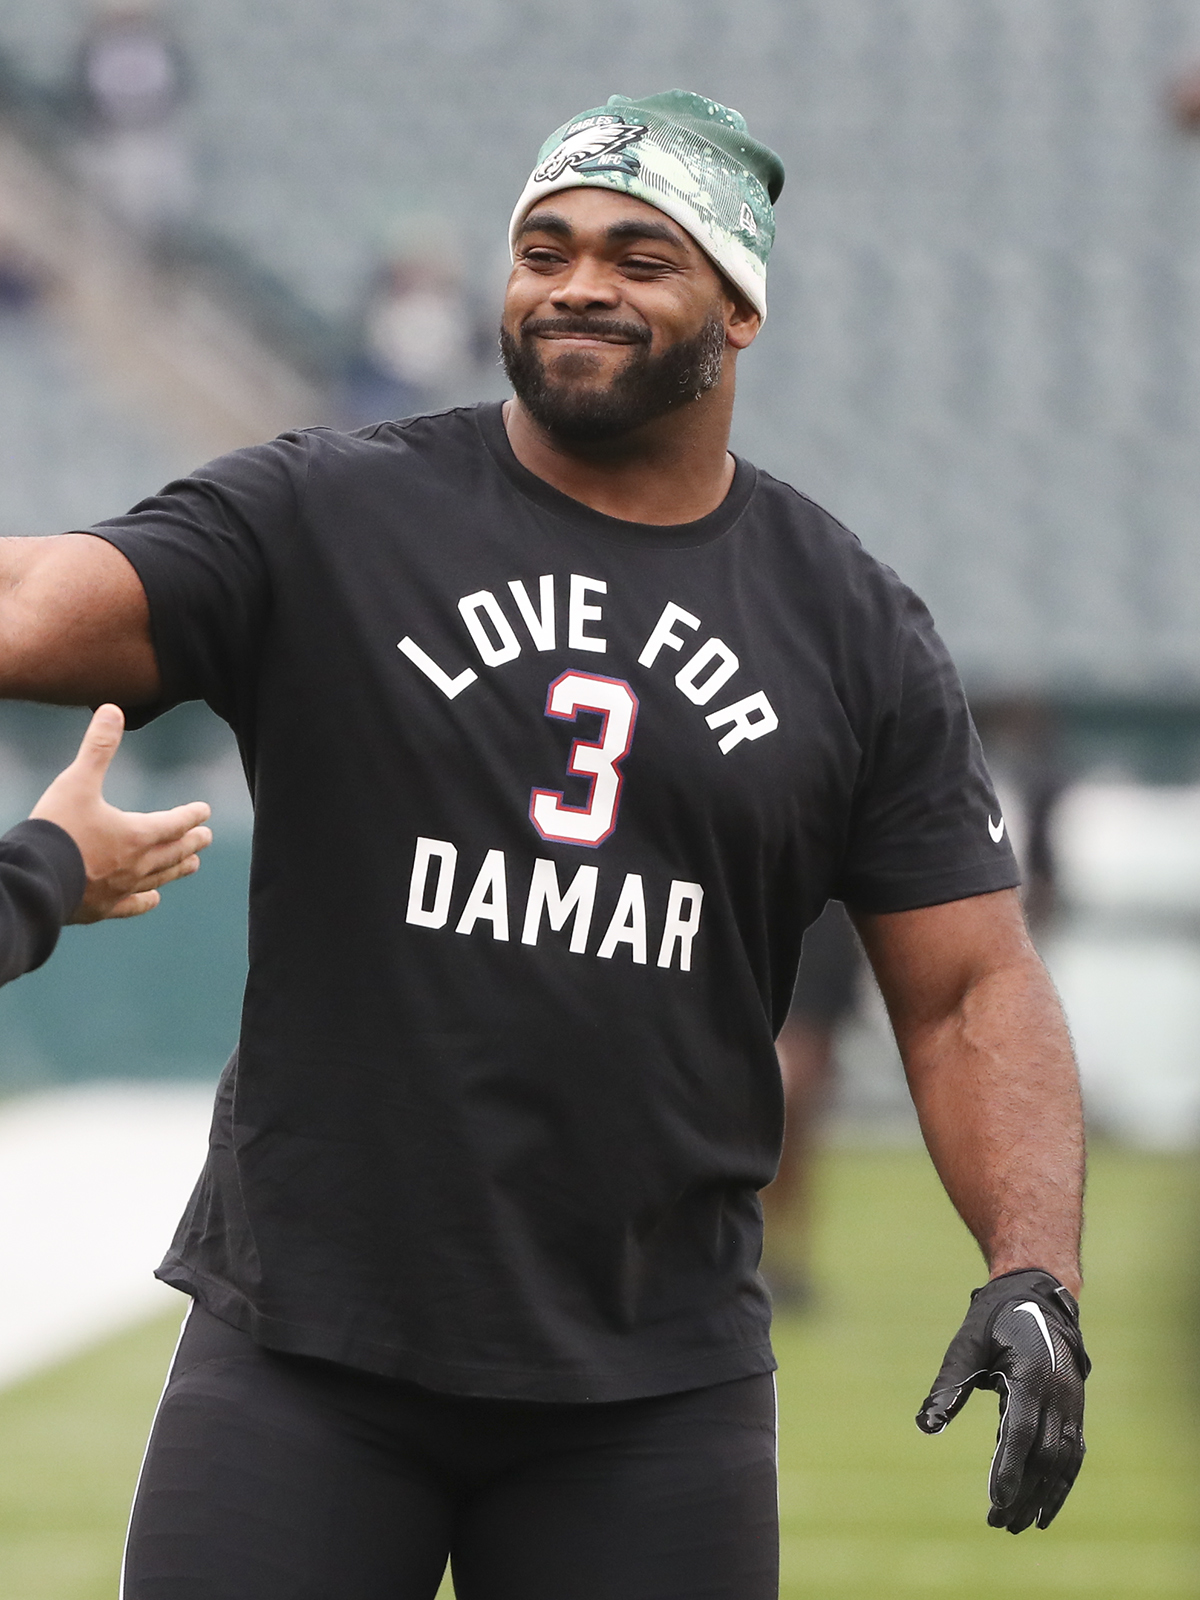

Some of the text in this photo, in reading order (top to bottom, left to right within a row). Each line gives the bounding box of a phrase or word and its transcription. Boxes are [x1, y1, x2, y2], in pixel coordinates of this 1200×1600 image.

[567, 116, 613, 134] EAGLES
[597, 154, 623, 165] NFC
[397, 574, 779, 755] LOVE FOR
[529, 668, 639, 849] 3
[405, 837, 704, 971] DAMAR
